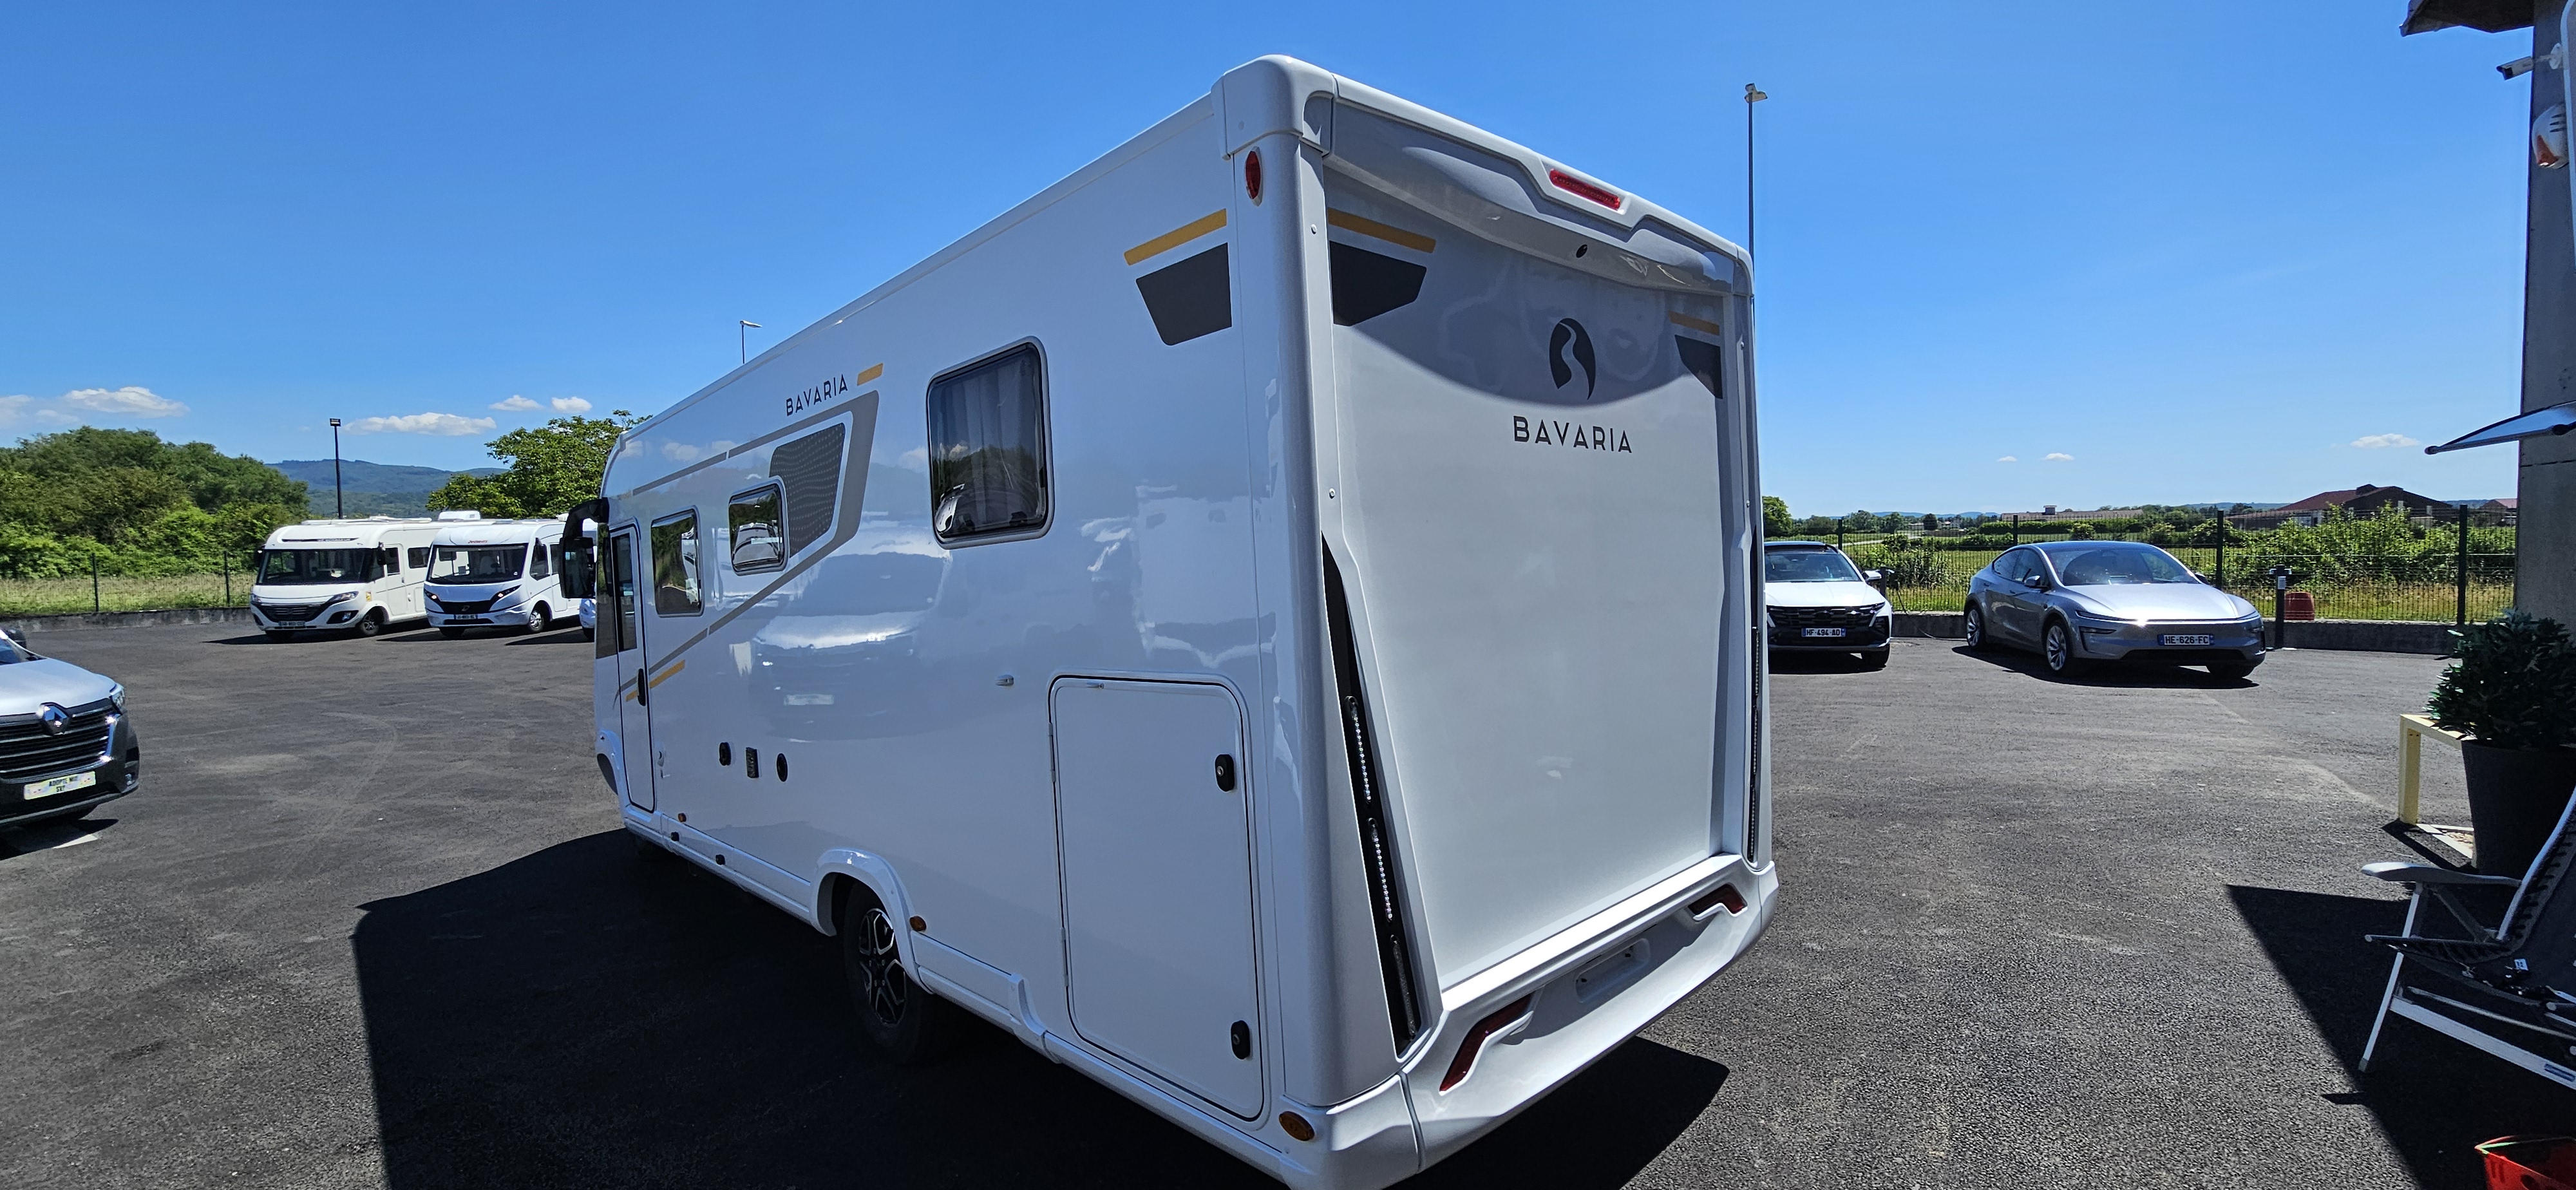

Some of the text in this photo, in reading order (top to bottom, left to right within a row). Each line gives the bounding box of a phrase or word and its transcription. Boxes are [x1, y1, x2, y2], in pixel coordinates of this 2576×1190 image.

[786, 373, 848, 417] BAVARIA
[1513, 415, 1633, 453] BAVARIA
[2164, 636, 2209, 644] HE-626-FC
